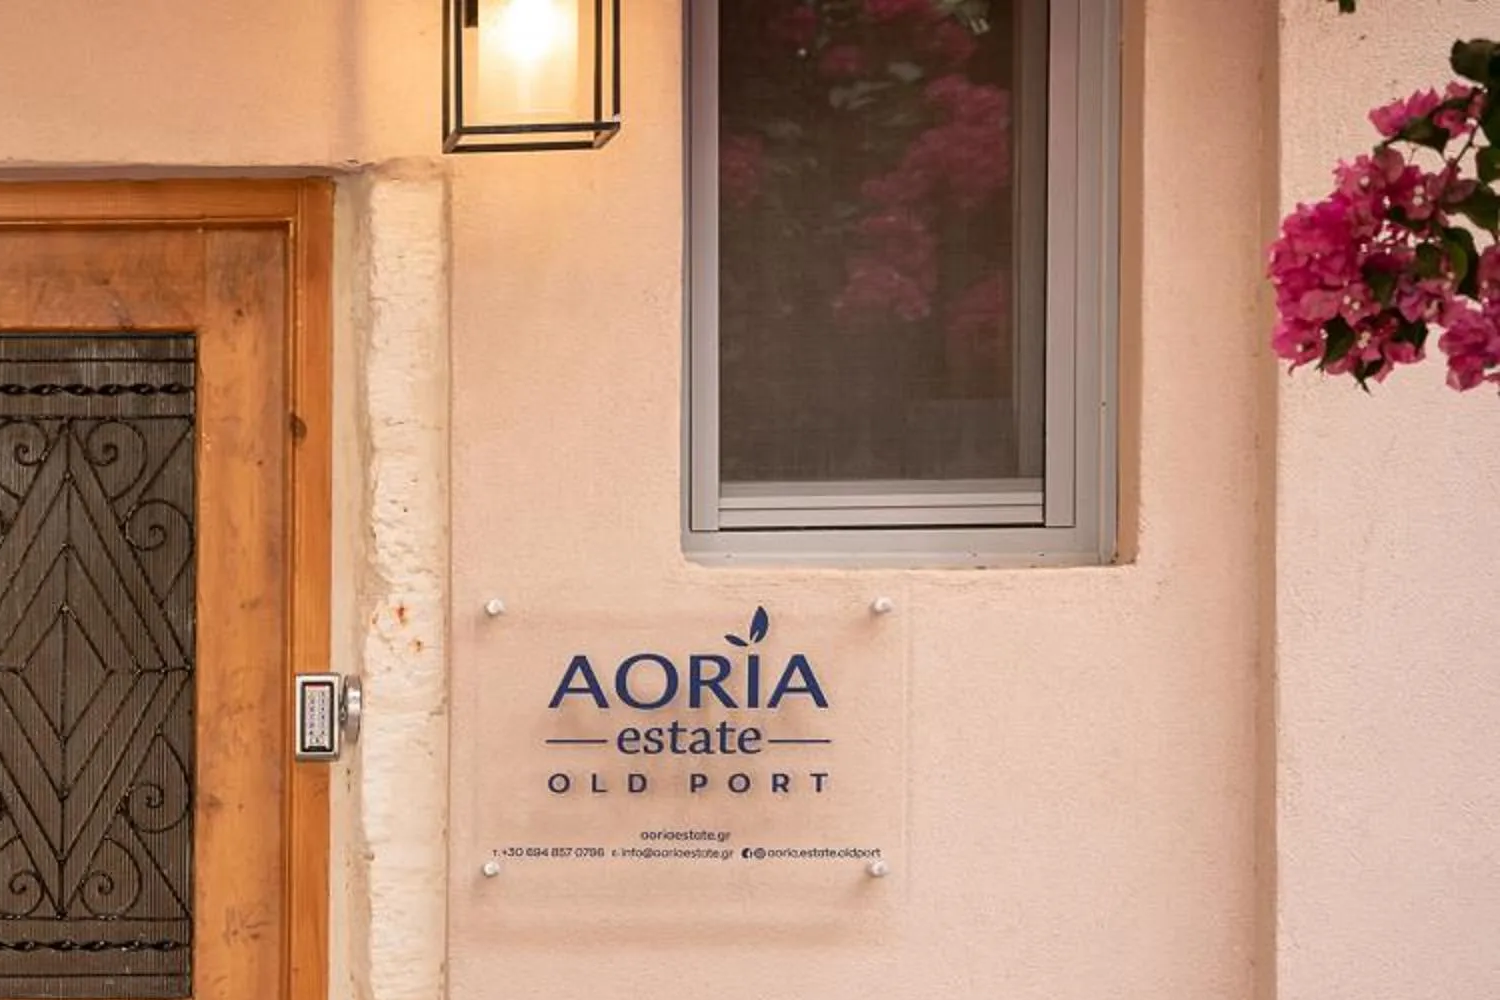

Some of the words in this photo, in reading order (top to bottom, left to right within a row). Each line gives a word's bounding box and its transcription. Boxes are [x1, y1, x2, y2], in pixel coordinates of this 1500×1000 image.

[548, 653, 829, 711] AORIA
[617, 719, 762, 755] estate
[548, 773, 648, 794] OLD
[690, 773, 829, 794] PORT
[640, 829, 731, 842] aoriaestate.gr
